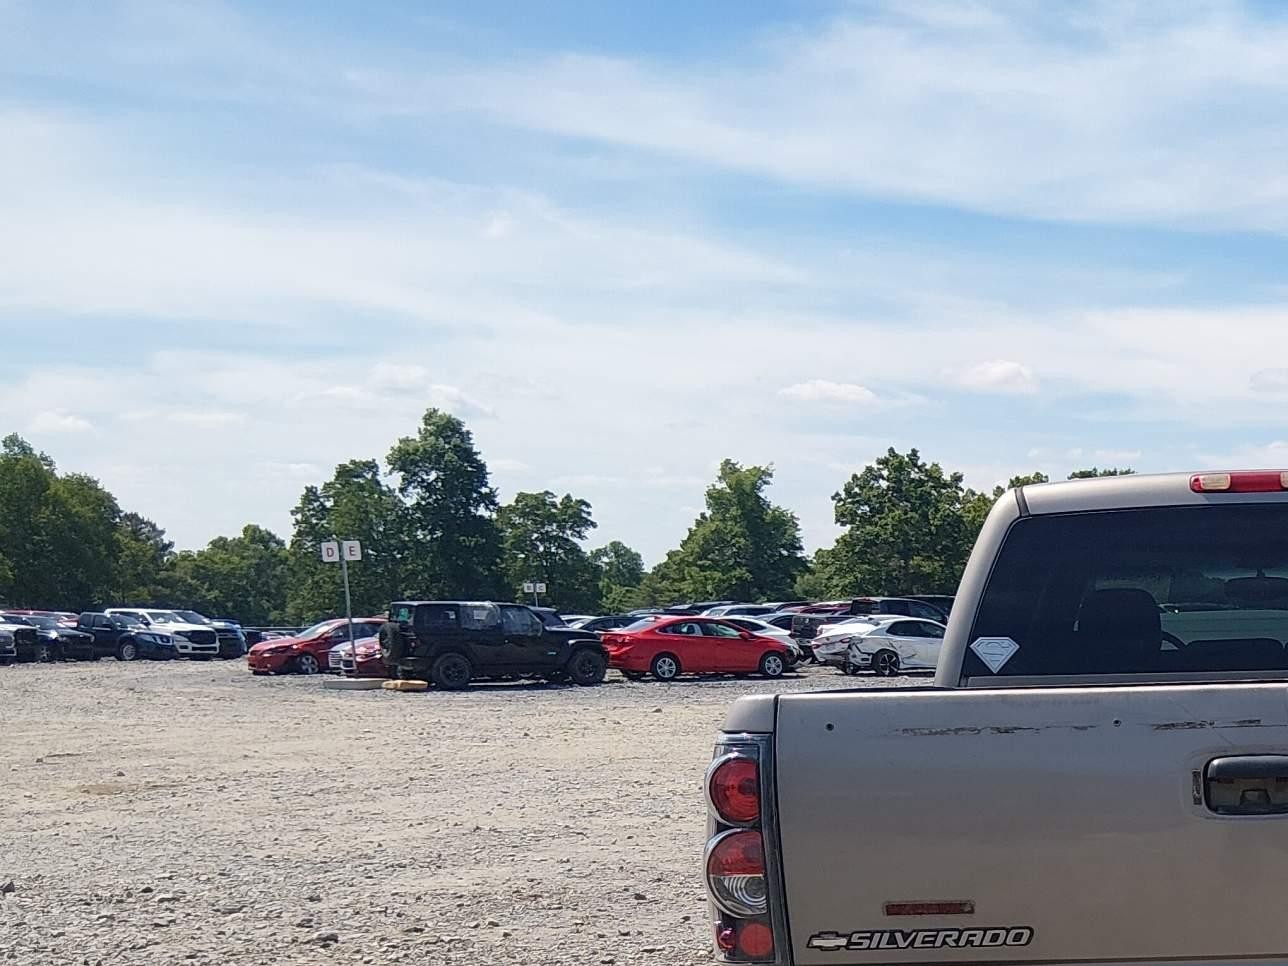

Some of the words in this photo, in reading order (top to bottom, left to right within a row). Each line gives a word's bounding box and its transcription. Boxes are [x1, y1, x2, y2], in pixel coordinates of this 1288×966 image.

[326, 547, 335, 558] D
[348, 545, 357, 557] E
[847, 926, 1034, 950] SILVERADO
